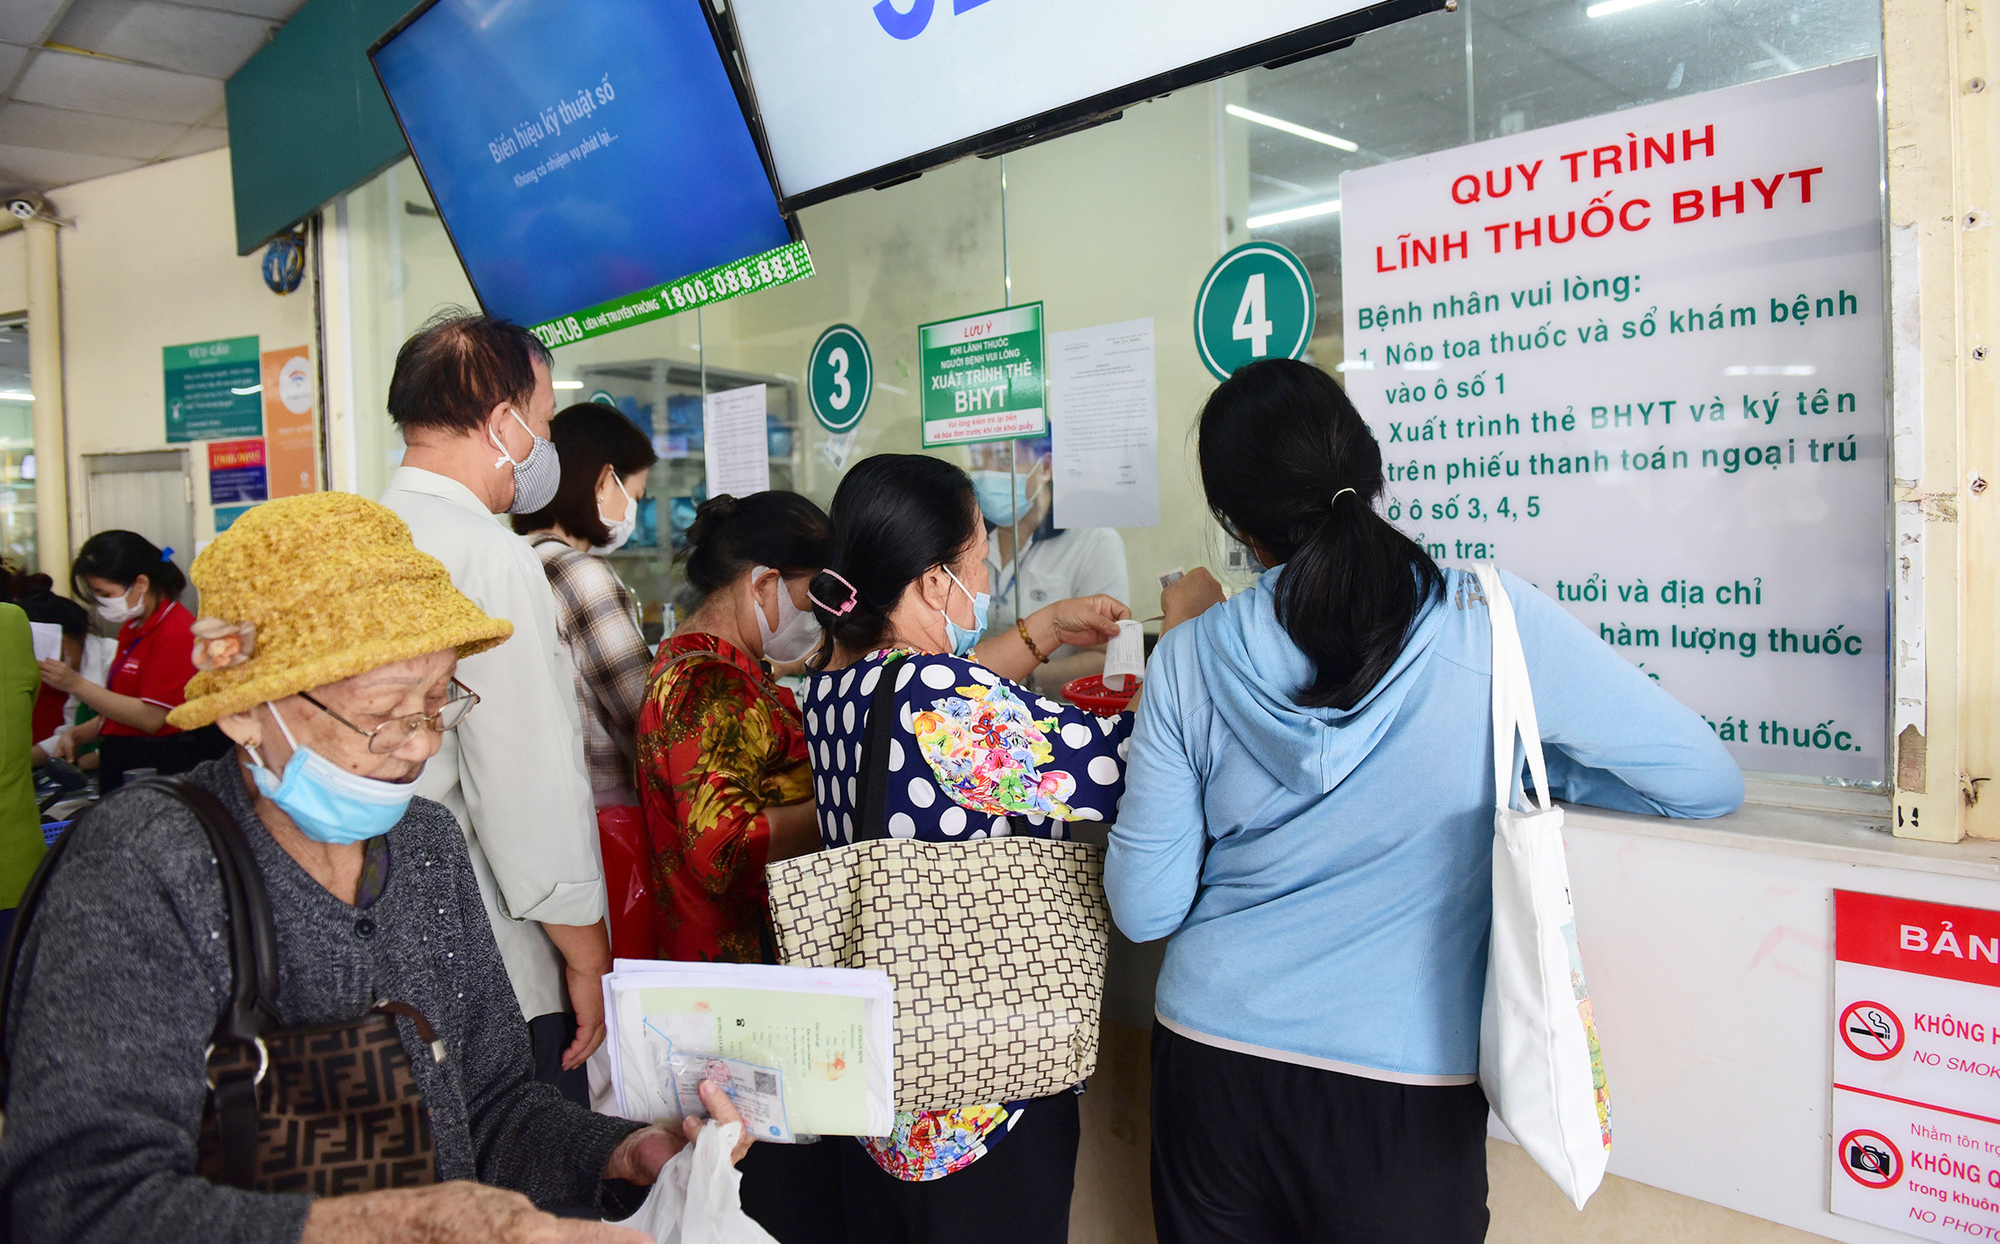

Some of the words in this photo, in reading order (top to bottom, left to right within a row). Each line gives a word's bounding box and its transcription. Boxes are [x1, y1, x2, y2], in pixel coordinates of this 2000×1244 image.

[488, 133, 518, 164] Biển
[513, 121, 544, 148] hiệu
[539, 106, 561, 137] kỹ
[558, 88, 597, 118] thuật
[595, 72, 615, 105] số
[1015, 121, 1037, 134] SONY
[513, 170, 539, 188] Không
[537, 161, 547, 177] có
[546, 152, 571, 171] nhiệm
[569, 147, 581, 160] vụ
[580, 135, 600, 158] phát
[1451, 158, 1545, 205] QUY
[1560, 123, 1716, 183] TRÌNH
[1376, 231, 1468, 273] LĨNH
[1484, 190, 1652, 255] THUỐC
[1672, 166, 1824, 226] BHYT
[581, 317, 599, 331] LIÊN
[596, 312, 609, 327] HỆ
[632, 298, 660, 316] THÔNG
[660, 252, 799, 311] 1800.088.881
[1358, 301, 1422, 332] Bệnh
[1433, 291, 1500, 320] nhân
[1510, 281, 1552, 309] vui
[1563, 274, 1641, 302] lòng:
[964, 324, 984, 338] LƯU
[986, 320, 993, 333] Ý
[1232, 273, 1273, 358] 4
[1443, 339, 1481, 359] toa
[1490, 321, 1567, 354] thuốc
[1577, 318, 1609, 344] và
[1622, 305, 1658, 339] sổ
[1670, 303, 1756, 334] khám
[1770, 289, 1858, 326] bệnh
[940, 357, 964, 370] NGƯỜI
[965, 353, 985, 366] BỆNH
[985, 351, 999, 362] VUI
[999, 348, 1021, 360] LÒNG
[950, 346, 963, 356] KHI
[983, 337, 1009, 350] THUỐC
[827, 346, 852, 411] 3
[931, 370, 964, 390] XUẤT
[965, 365, 1003, 384] TRÌNH
[1006, 358, 1032, 378] THẺ
[1385, 382, 1426, 404] vào
[1434, 378, 1448, 400] ô
[1456, 370, 1487, 399] số
[1495, 372, 1505, 394] 1
[955, 384, 1008, 413] BHYT
[1389, 415, 1447, 443] Xuất
[1456, 413, 1520, 439] trình
[1530, 405, 1576, 433] thẻ
[1591, 400, 1677, 430] BHYT
[1689, 396, 1725, 422] và
[1743, 391, 1780, 425] ký
[1797, 387, 1856, 416] tên
[983, 425, 992, 434] khi
[987, 416, 996, 424] tra
[1388, 460, 1436, 482] trên
[1446, 451, 1520, 485] phiếu
[1529, 450, 1609, 475] thanh
[1620, 445, 1688, 471] toán
[1702, 438, 1795, 474] ngoại
[1808, 434, 1857, 463] trú
[1388, 497, 1402, 521] ở
[1410, 499, 1423, 520] ô
[1431, 494, 1461, 520] số
[1468, 498, 1488, 523] 3,
[1497, 496, 1517, 523] 4,
[1527, 496, 1541, 518] 5
[1455, 539, 1495, 560] tra:
[1557, 572, 1607, 602] tuổi
[1617, 579, 1649, 603] và
[1660, 579, 1704, 609] địa
[1716, 577, 1762, 605] chỉ
[1600, 622, 1659, 647] hàm
[1672, 624, 1756, 658] lượng
[1768, 624, 1863, 656] thuốc
[1759, 719, 1861, 752] thuốc.
[1900, 921, 1999, 965] BẢN
[1914, 1012, 1985, 1043] KHÔNG
[1913, 1049, 1941, 1067] NO
[1947, 1056, 2000, 1079] SMOK
[1911, 1122, 1952, 1144] Nhằm
[1957, 1135, 1980, 1150] tôn
[1911, 1150, 1981, 1184] KHÔNG
[1909, 1180, 1948, 1202] trong
[1952, 1190, 2000, 1213] khuôn
[1909, 1207, 1937, 1223] NO
